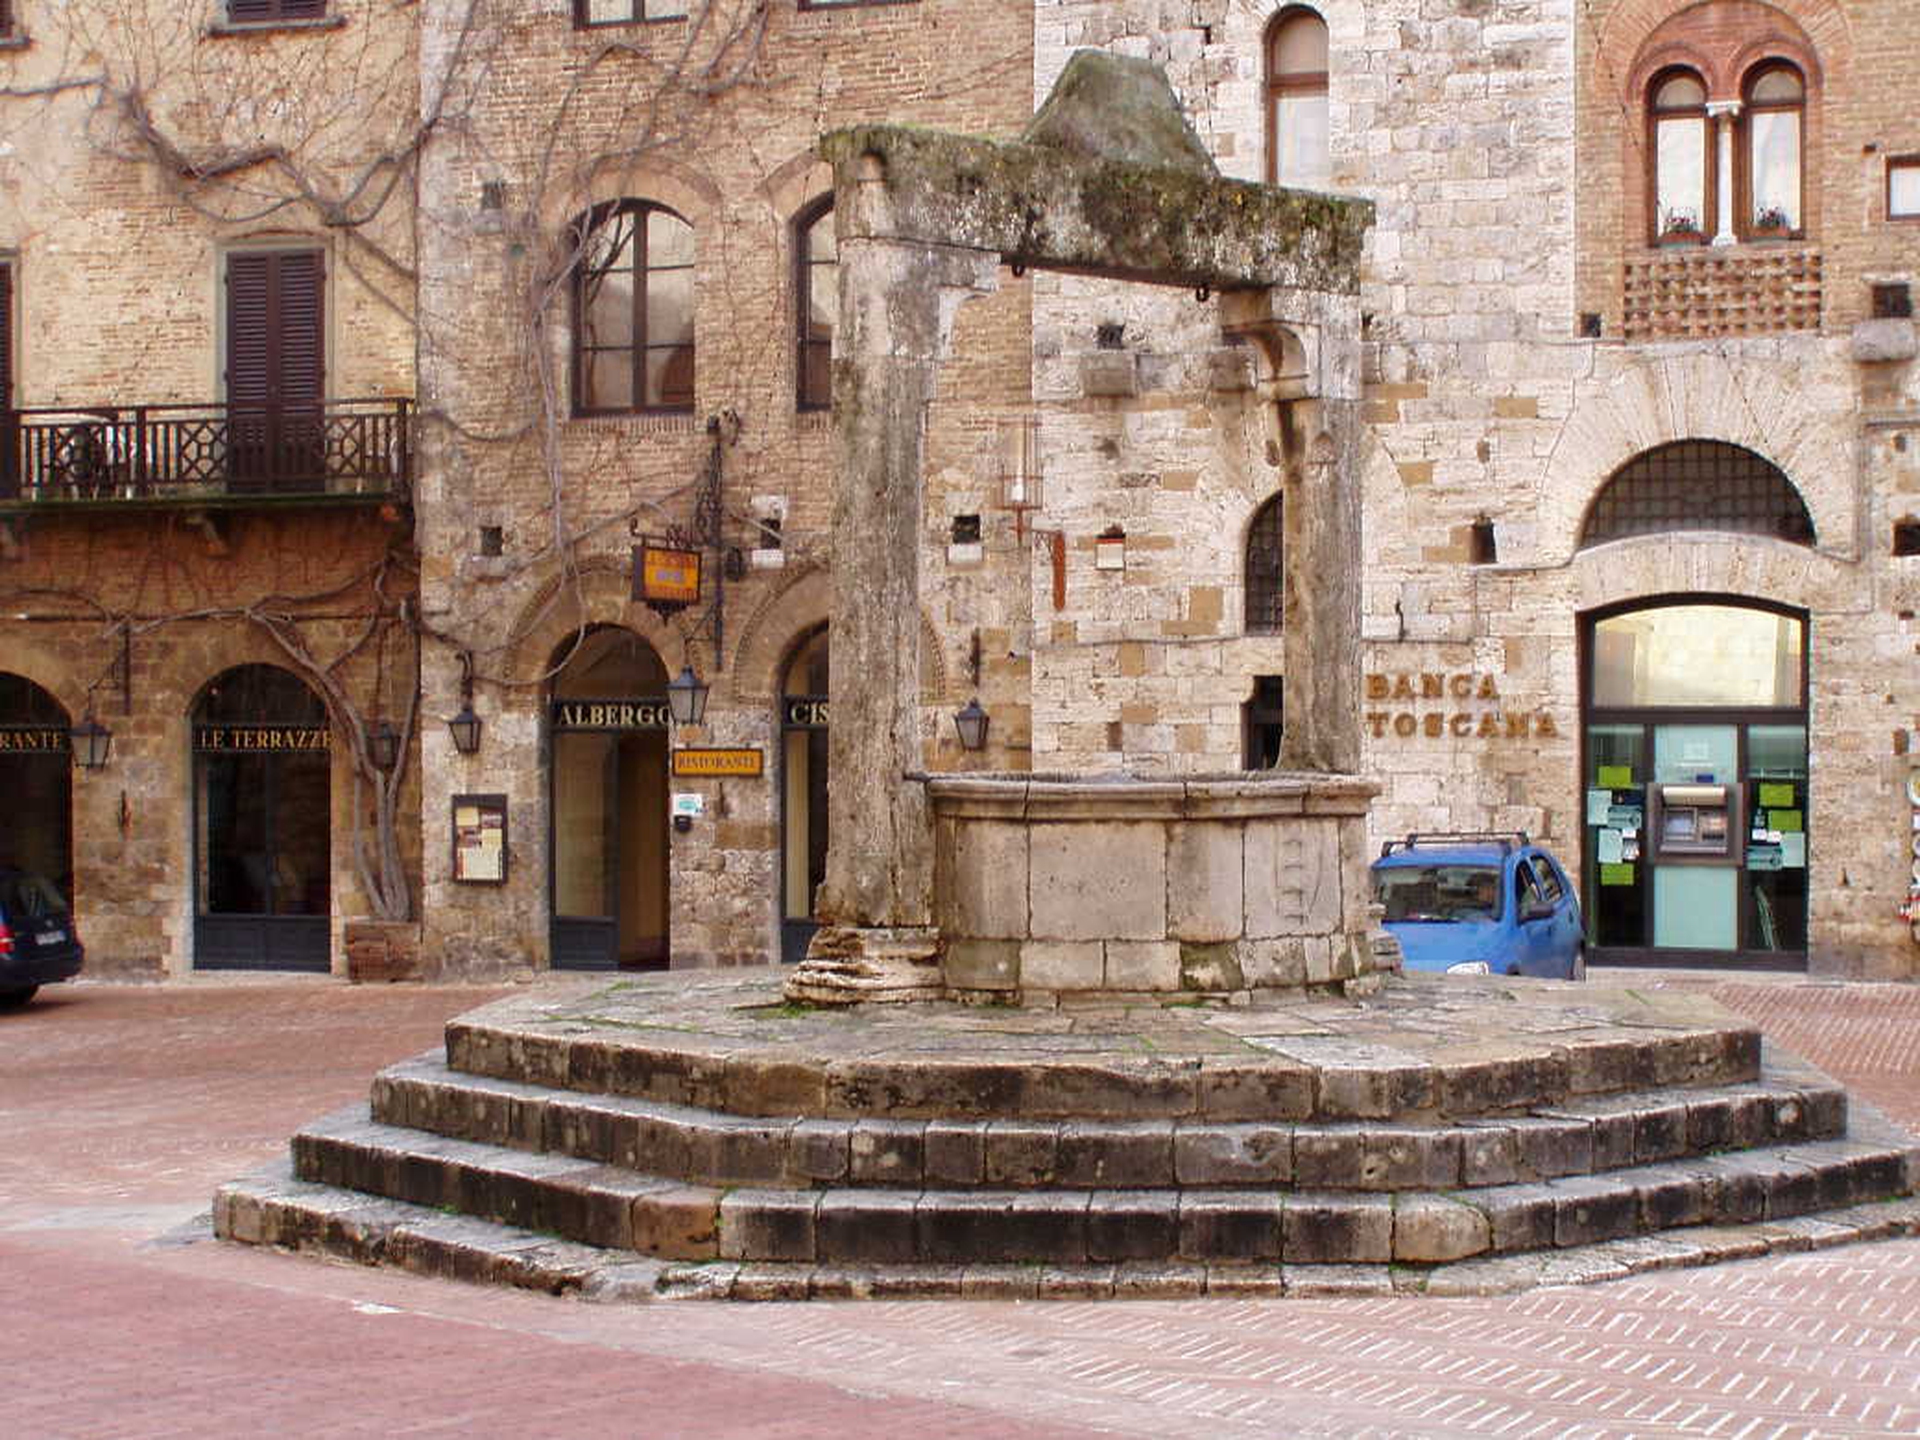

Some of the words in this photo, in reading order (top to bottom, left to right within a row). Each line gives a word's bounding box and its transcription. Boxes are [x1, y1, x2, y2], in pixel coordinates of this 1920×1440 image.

[1366, 673, 1500, 698] BANCA
[561, 705, 670, 724] ALBERGO
[1366, 712, 1558, 738] TOSCANA
[202, 730, 224, 748] LE
